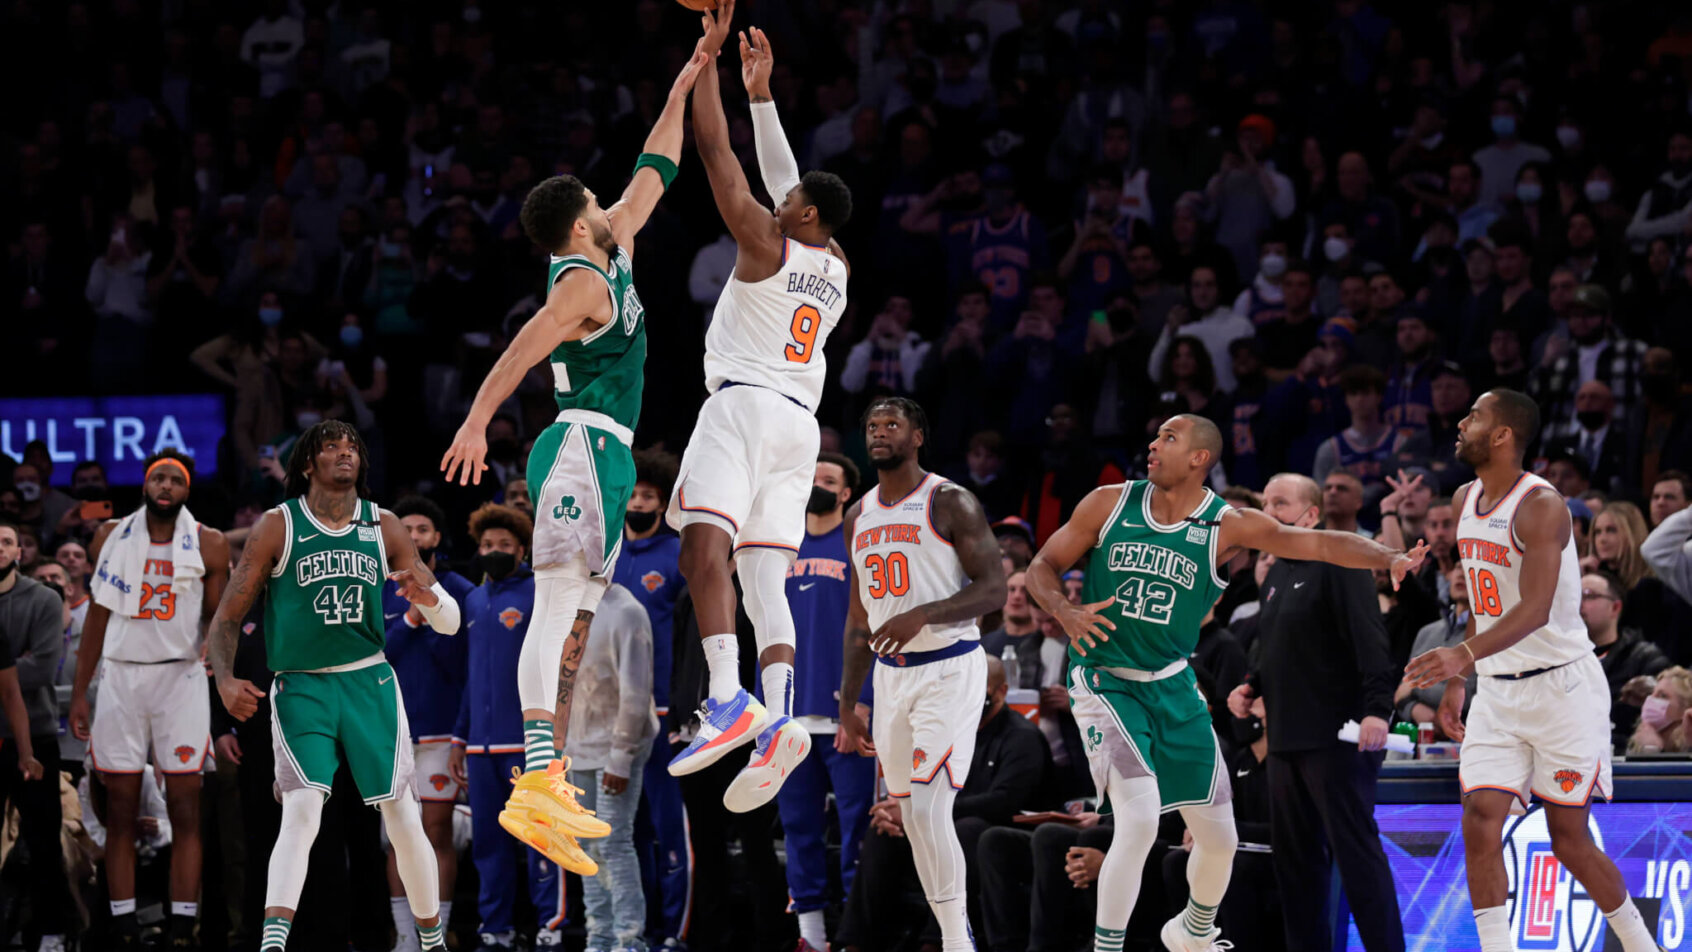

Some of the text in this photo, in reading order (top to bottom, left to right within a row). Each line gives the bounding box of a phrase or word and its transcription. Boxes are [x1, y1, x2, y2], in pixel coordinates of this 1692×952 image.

[787, 272, 841, 310] BARRETT
[784, 303, 821, 363] 9
[1, 415, 190, 464] ULTRA
[557, 507, 577, 515] RED
[856, 524, 922, 552] NEW YORK
[1474, 538, 1511, 568] YORK
[296, 550, 378, 587] CELTICS
[786, 558, 847, 581] EW YORK
[865, 552, 910, 599] 30
[1108, 542, 1198, 590] CELTICS
[131, 581, 177, 620] 23
[313, 585, 364, 625] 44
[1116, 577, 1176, 624] 42
[1468, 567, 1502, 616] 18
